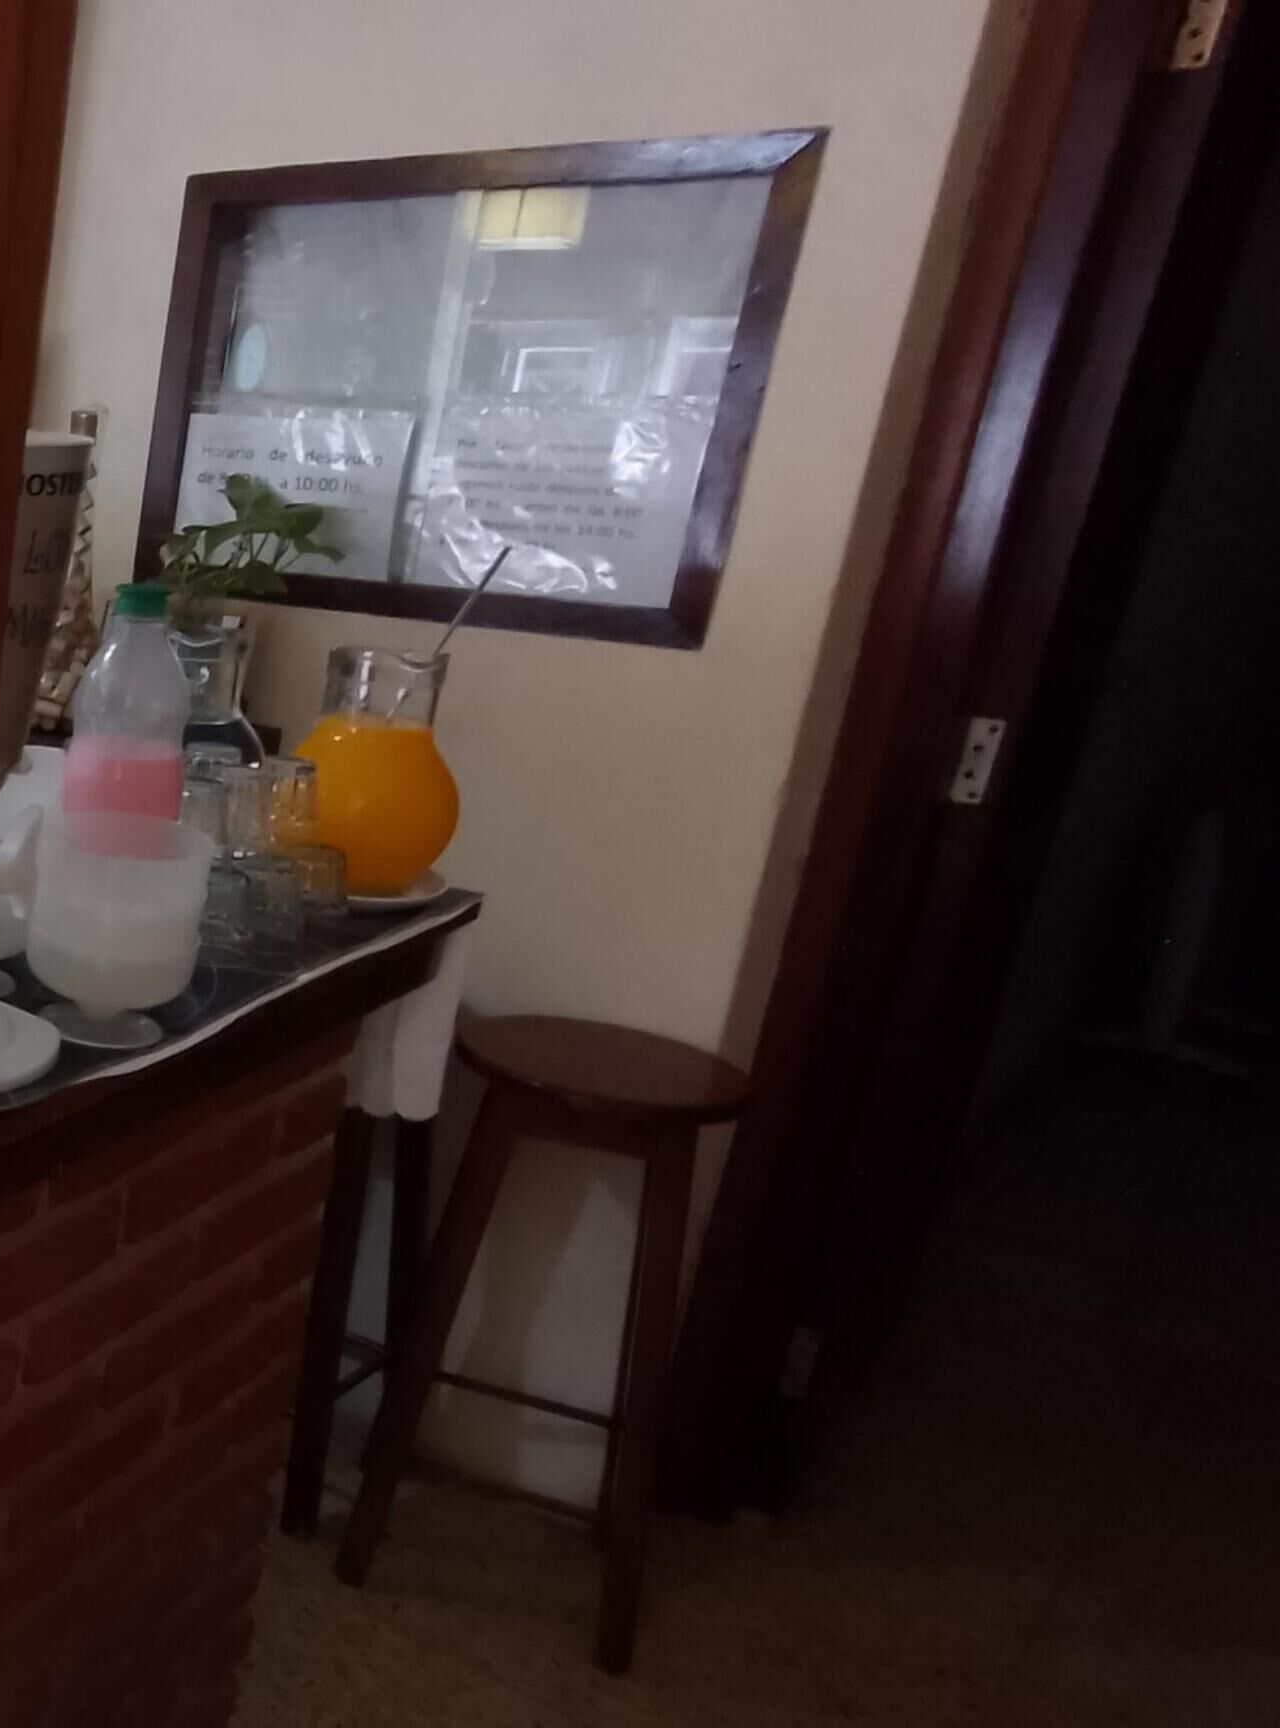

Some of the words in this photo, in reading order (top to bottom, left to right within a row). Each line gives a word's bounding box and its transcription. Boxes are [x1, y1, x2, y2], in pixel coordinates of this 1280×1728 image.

[202, 445, 255, 460] Horario
[269, 447, 288, 462] de
[197, 471, 215, 484] de
[279, 479, 289, 490] a
